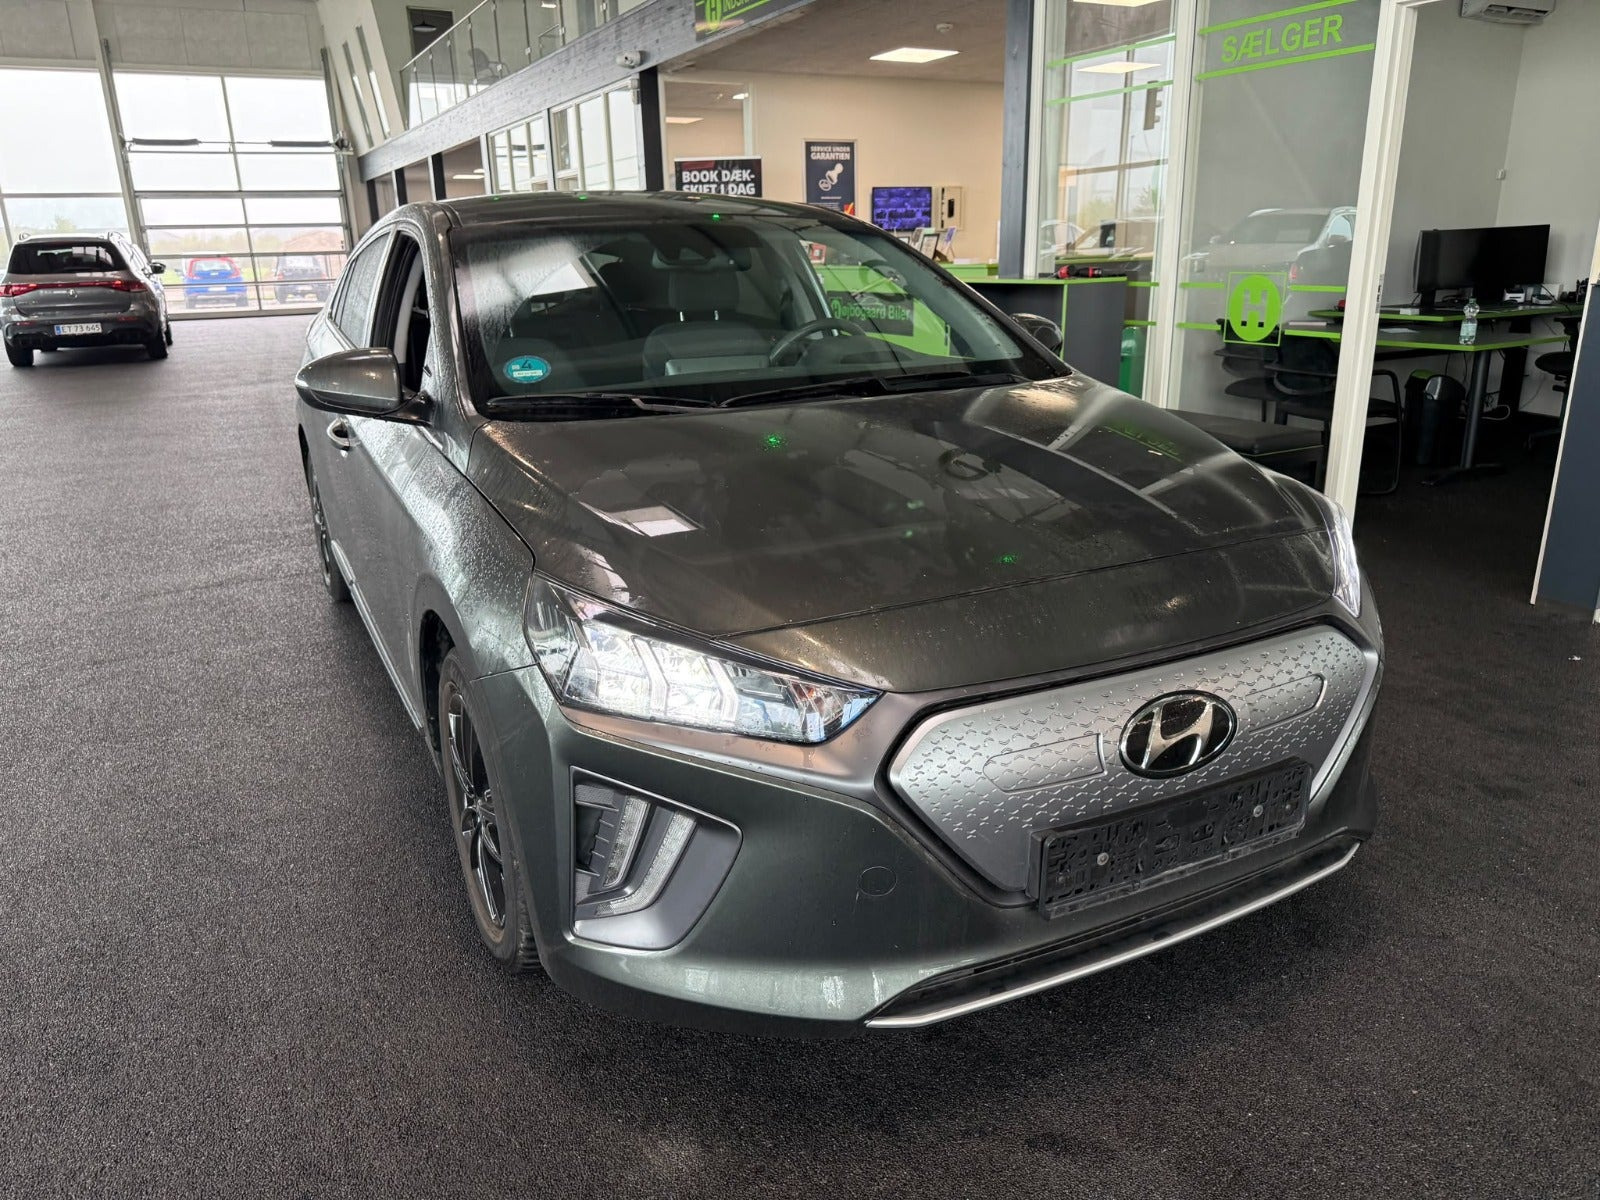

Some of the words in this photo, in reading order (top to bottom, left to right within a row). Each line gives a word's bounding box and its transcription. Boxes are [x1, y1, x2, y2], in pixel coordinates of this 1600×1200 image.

[1221, 14, 1343, 63] SÆLGER
[810, 152, 850, 160] GARANTIEN
[682, 170, 719, 183] BOOK
[721, 169, 756, 182] DÆK-
[682, 184, 717, 194] SKIFT
[727, 183, 756, 195] DAG
[62, 325, 71, 333] ET
